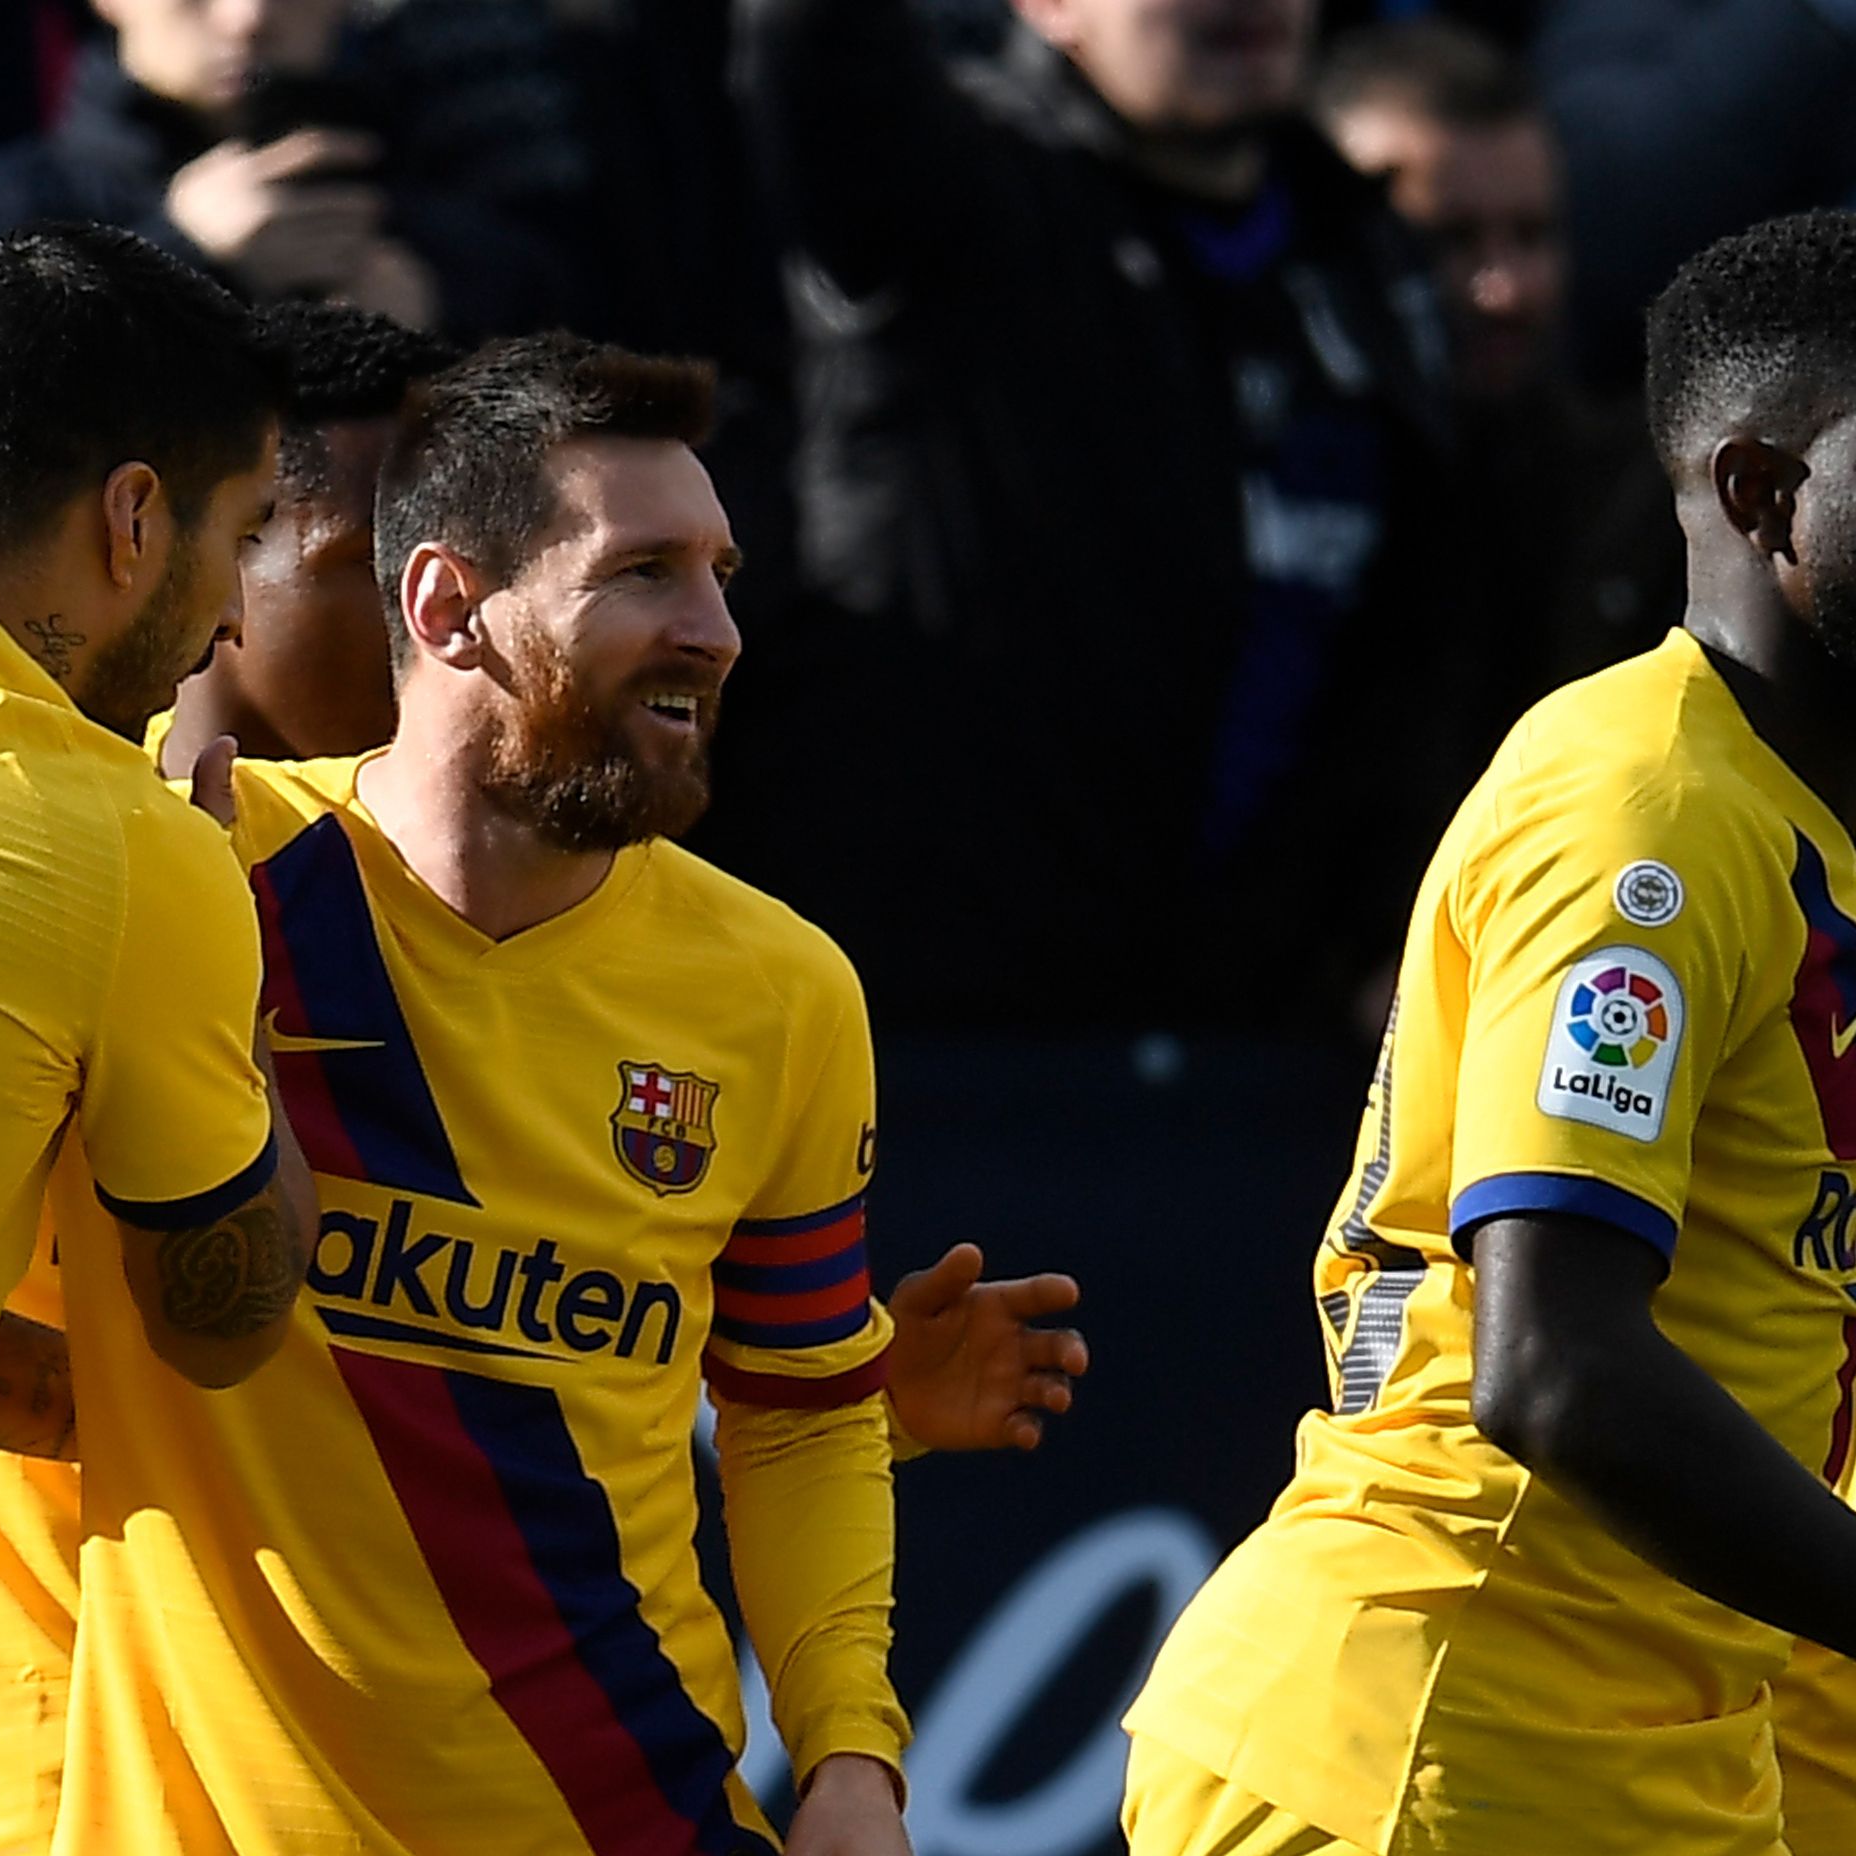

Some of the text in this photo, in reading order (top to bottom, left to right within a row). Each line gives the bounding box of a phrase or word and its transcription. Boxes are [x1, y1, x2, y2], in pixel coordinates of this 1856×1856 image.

[1552, 1066, 1653, 1117] LaLiga
[646, 1116, 687, 1139] FCB
[306, 1199, 683, 1365] akuten
